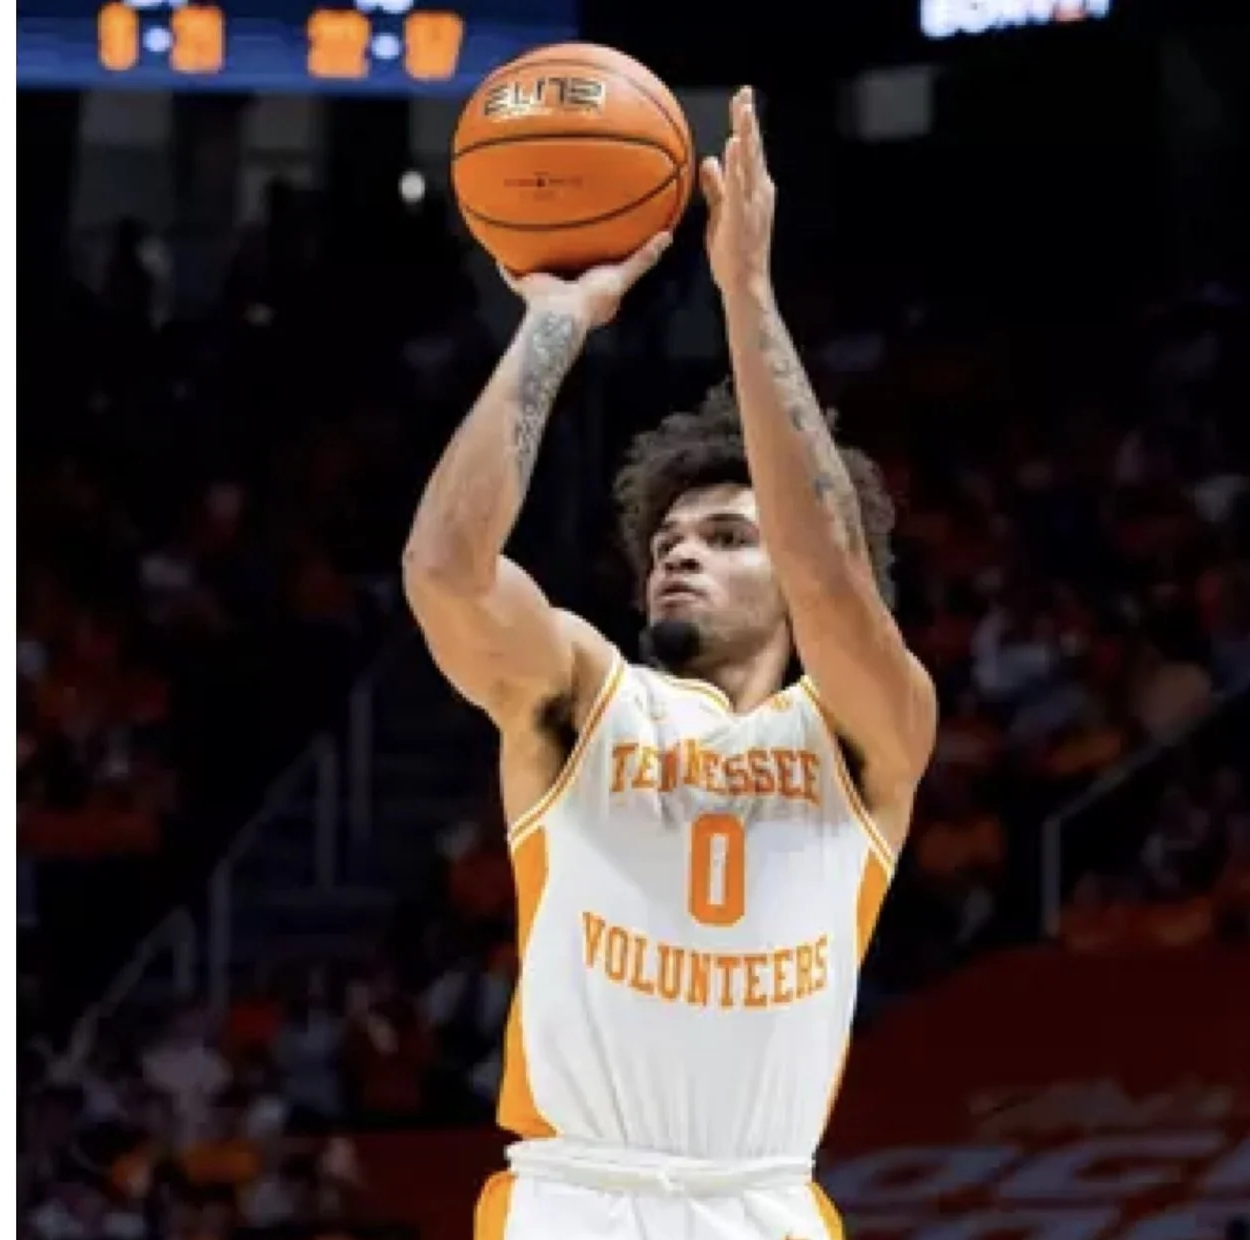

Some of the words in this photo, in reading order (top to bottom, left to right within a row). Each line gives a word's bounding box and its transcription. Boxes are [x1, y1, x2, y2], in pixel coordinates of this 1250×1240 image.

[611, 740, 818, 806] TENNESSEE
[689, 812, 746, 927] 0
[582, 910, 828, 1008] VOLUNTEERS
